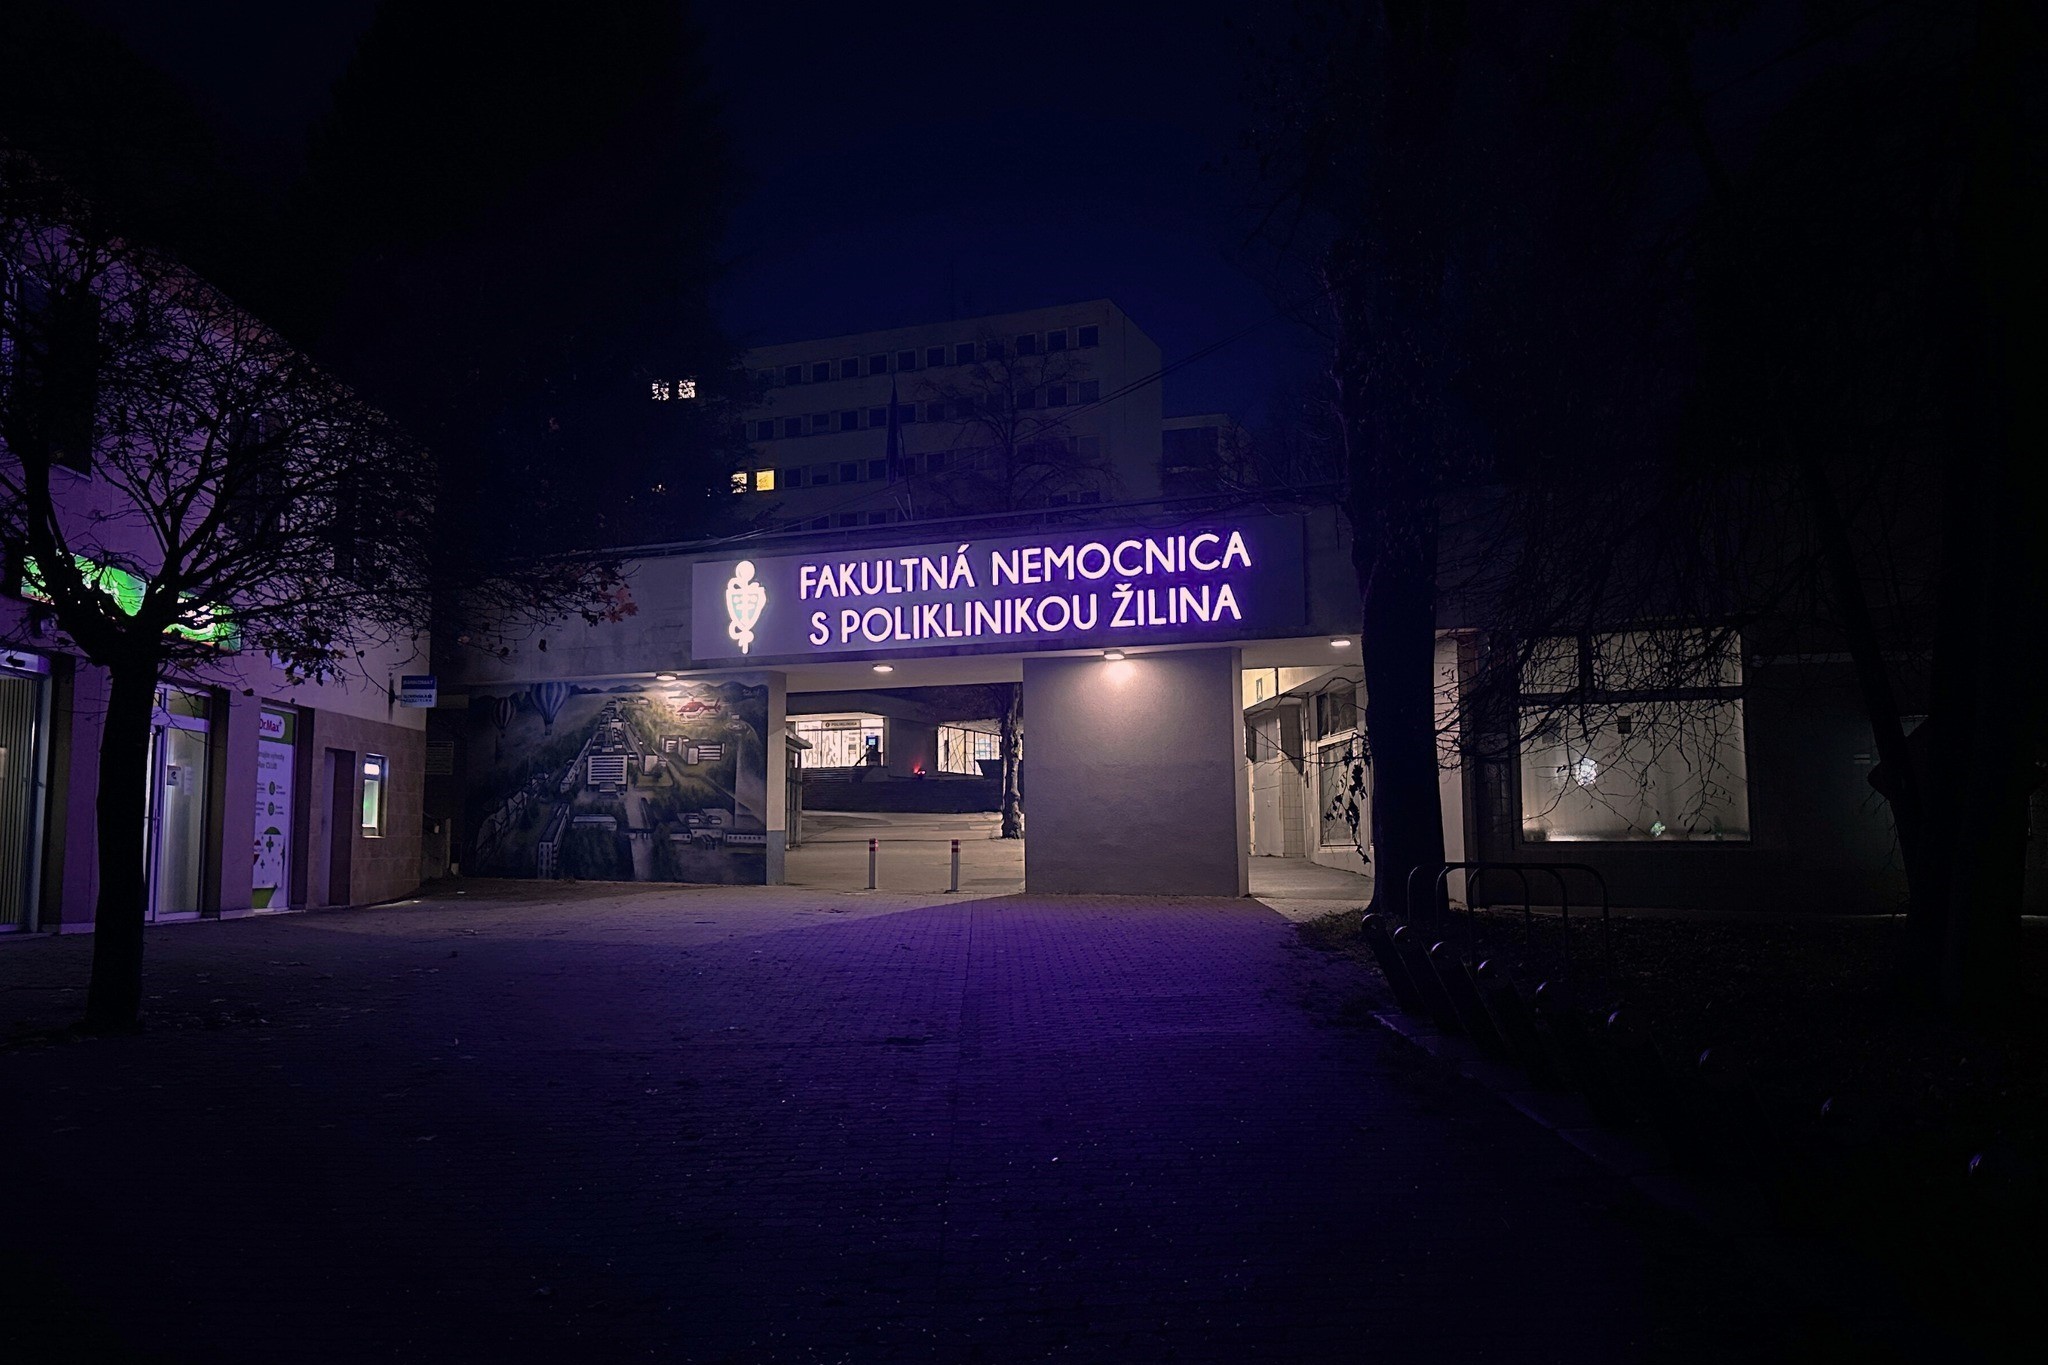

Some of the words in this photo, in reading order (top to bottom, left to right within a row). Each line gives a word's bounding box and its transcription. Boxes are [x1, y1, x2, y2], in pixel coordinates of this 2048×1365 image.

[799, 543, 976, 600] FAKULTNÁ
[991, 531, 1252, 586] NEMOCNICA
[809, 611, 831, 646] S
[841, 593, 1098, 644] POLIKLINIKOU
[1109, 583, 1242, 628] ŽILINA
